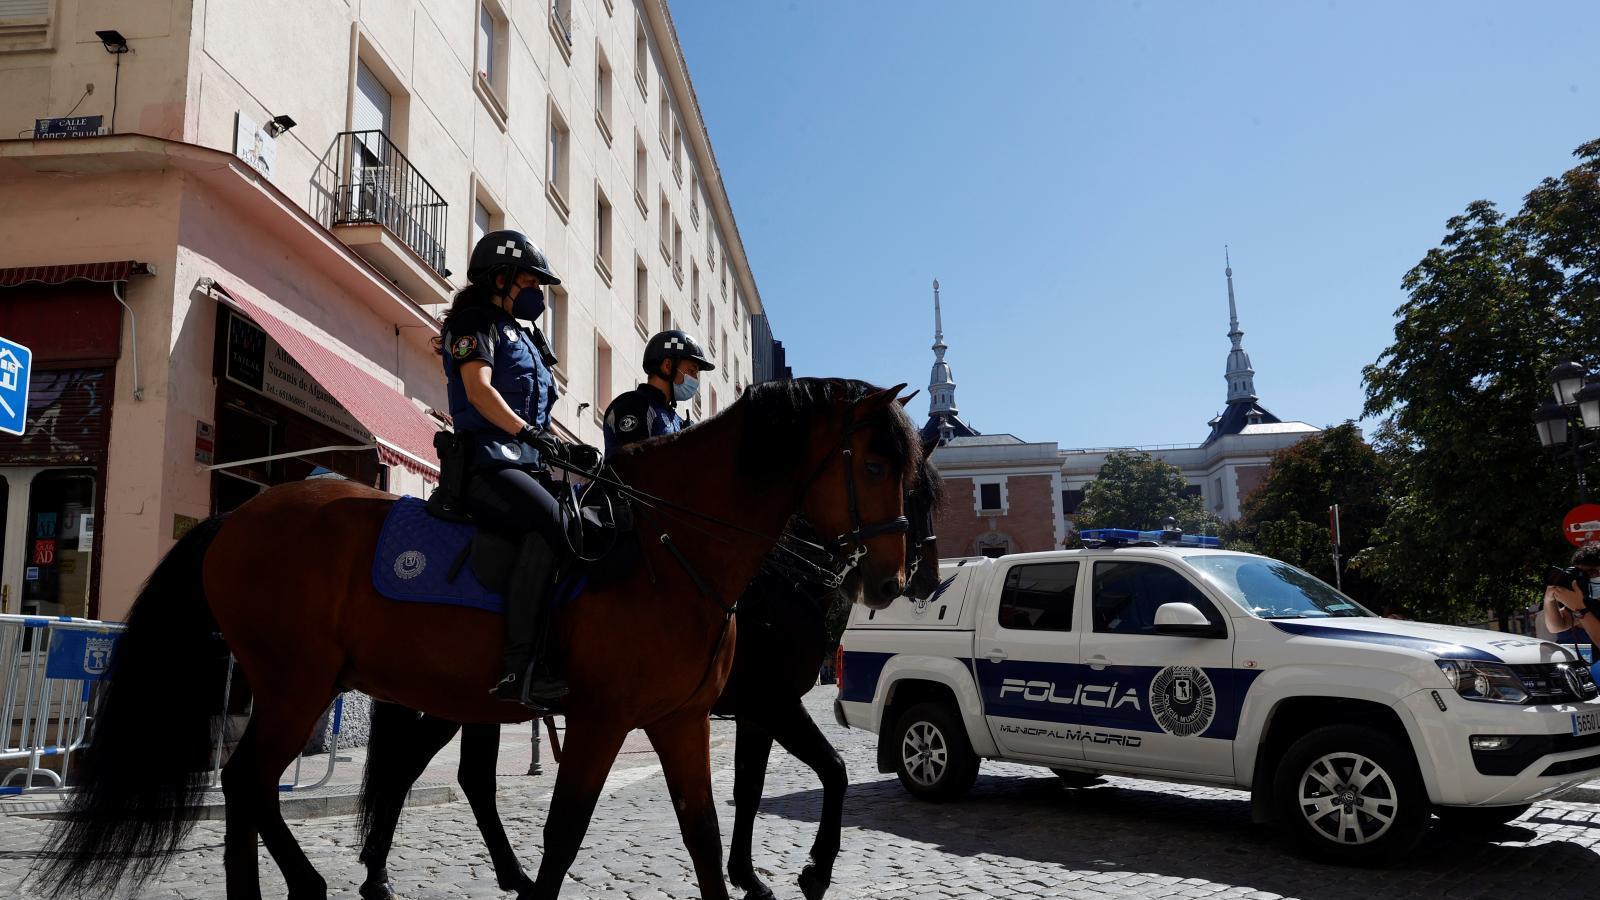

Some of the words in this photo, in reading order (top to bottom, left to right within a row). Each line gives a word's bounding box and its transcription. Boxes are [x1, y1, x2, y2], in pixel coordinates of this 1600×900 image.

[59, 118, 87, 127] CALLE
[268, 361, 298, 386] Suzanis
[298, 377, 309, 391] de
[36, 550, 53, 564] AD
[1000, 678, 1141, 711] POLICÍA
[1577, 714, 1596, 732] 5650
[1000, 724, 1065, 739] MUNICIPAL
[1065, 729, 1142, 748] MADRID
